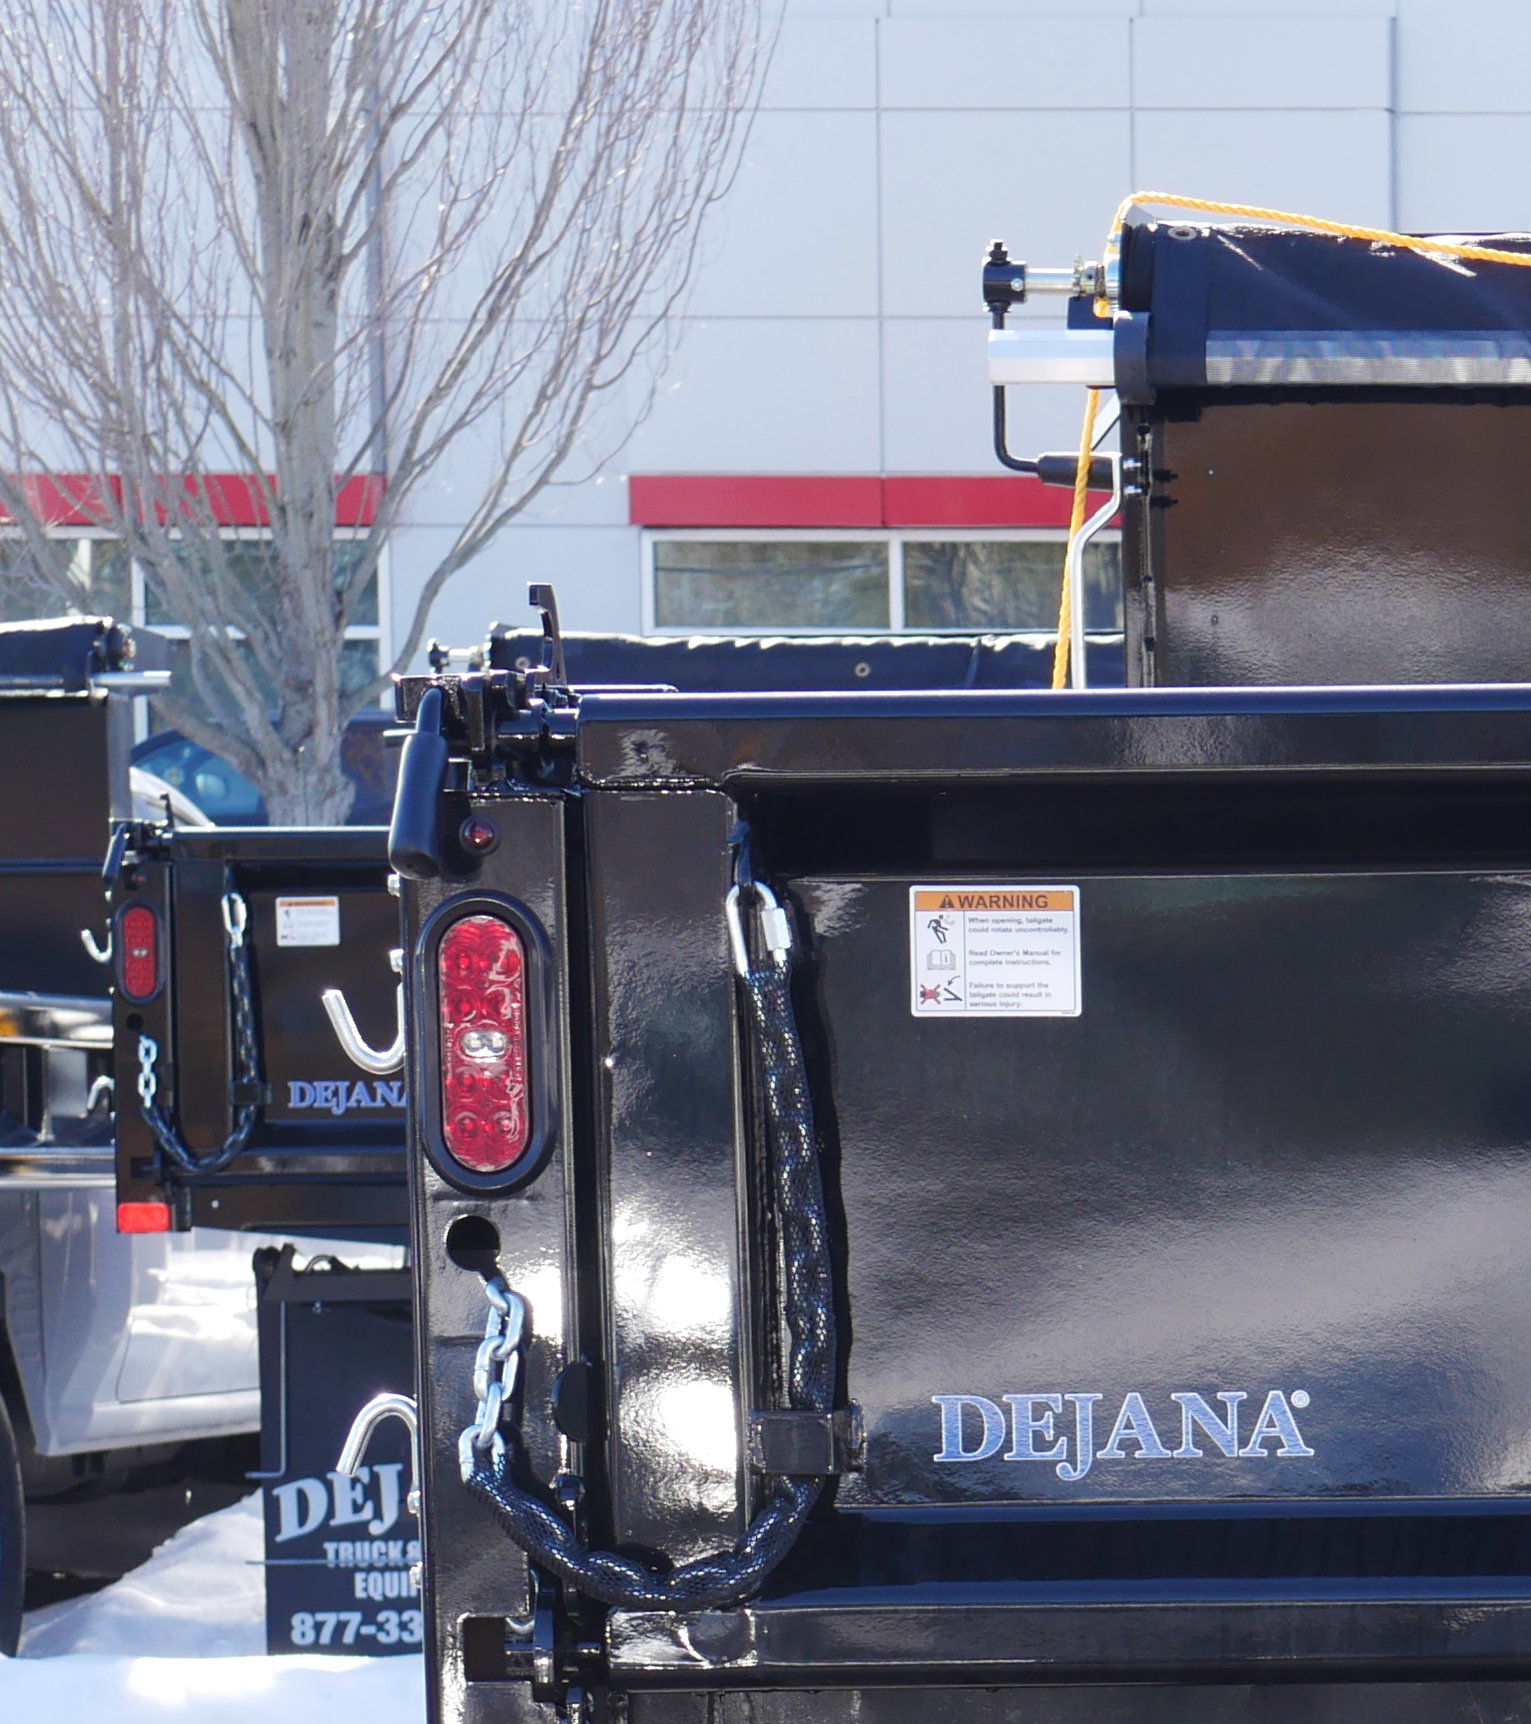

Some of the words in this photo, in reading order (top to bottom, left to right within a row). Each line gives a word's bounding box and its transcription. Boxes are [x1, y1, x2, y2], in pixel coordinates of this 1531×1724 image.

[957, 894, 1049, 909] WARNING
[287, 1080, 407, 1115] DEJAN
[323, 1541, 404, 1568] TRUCK
